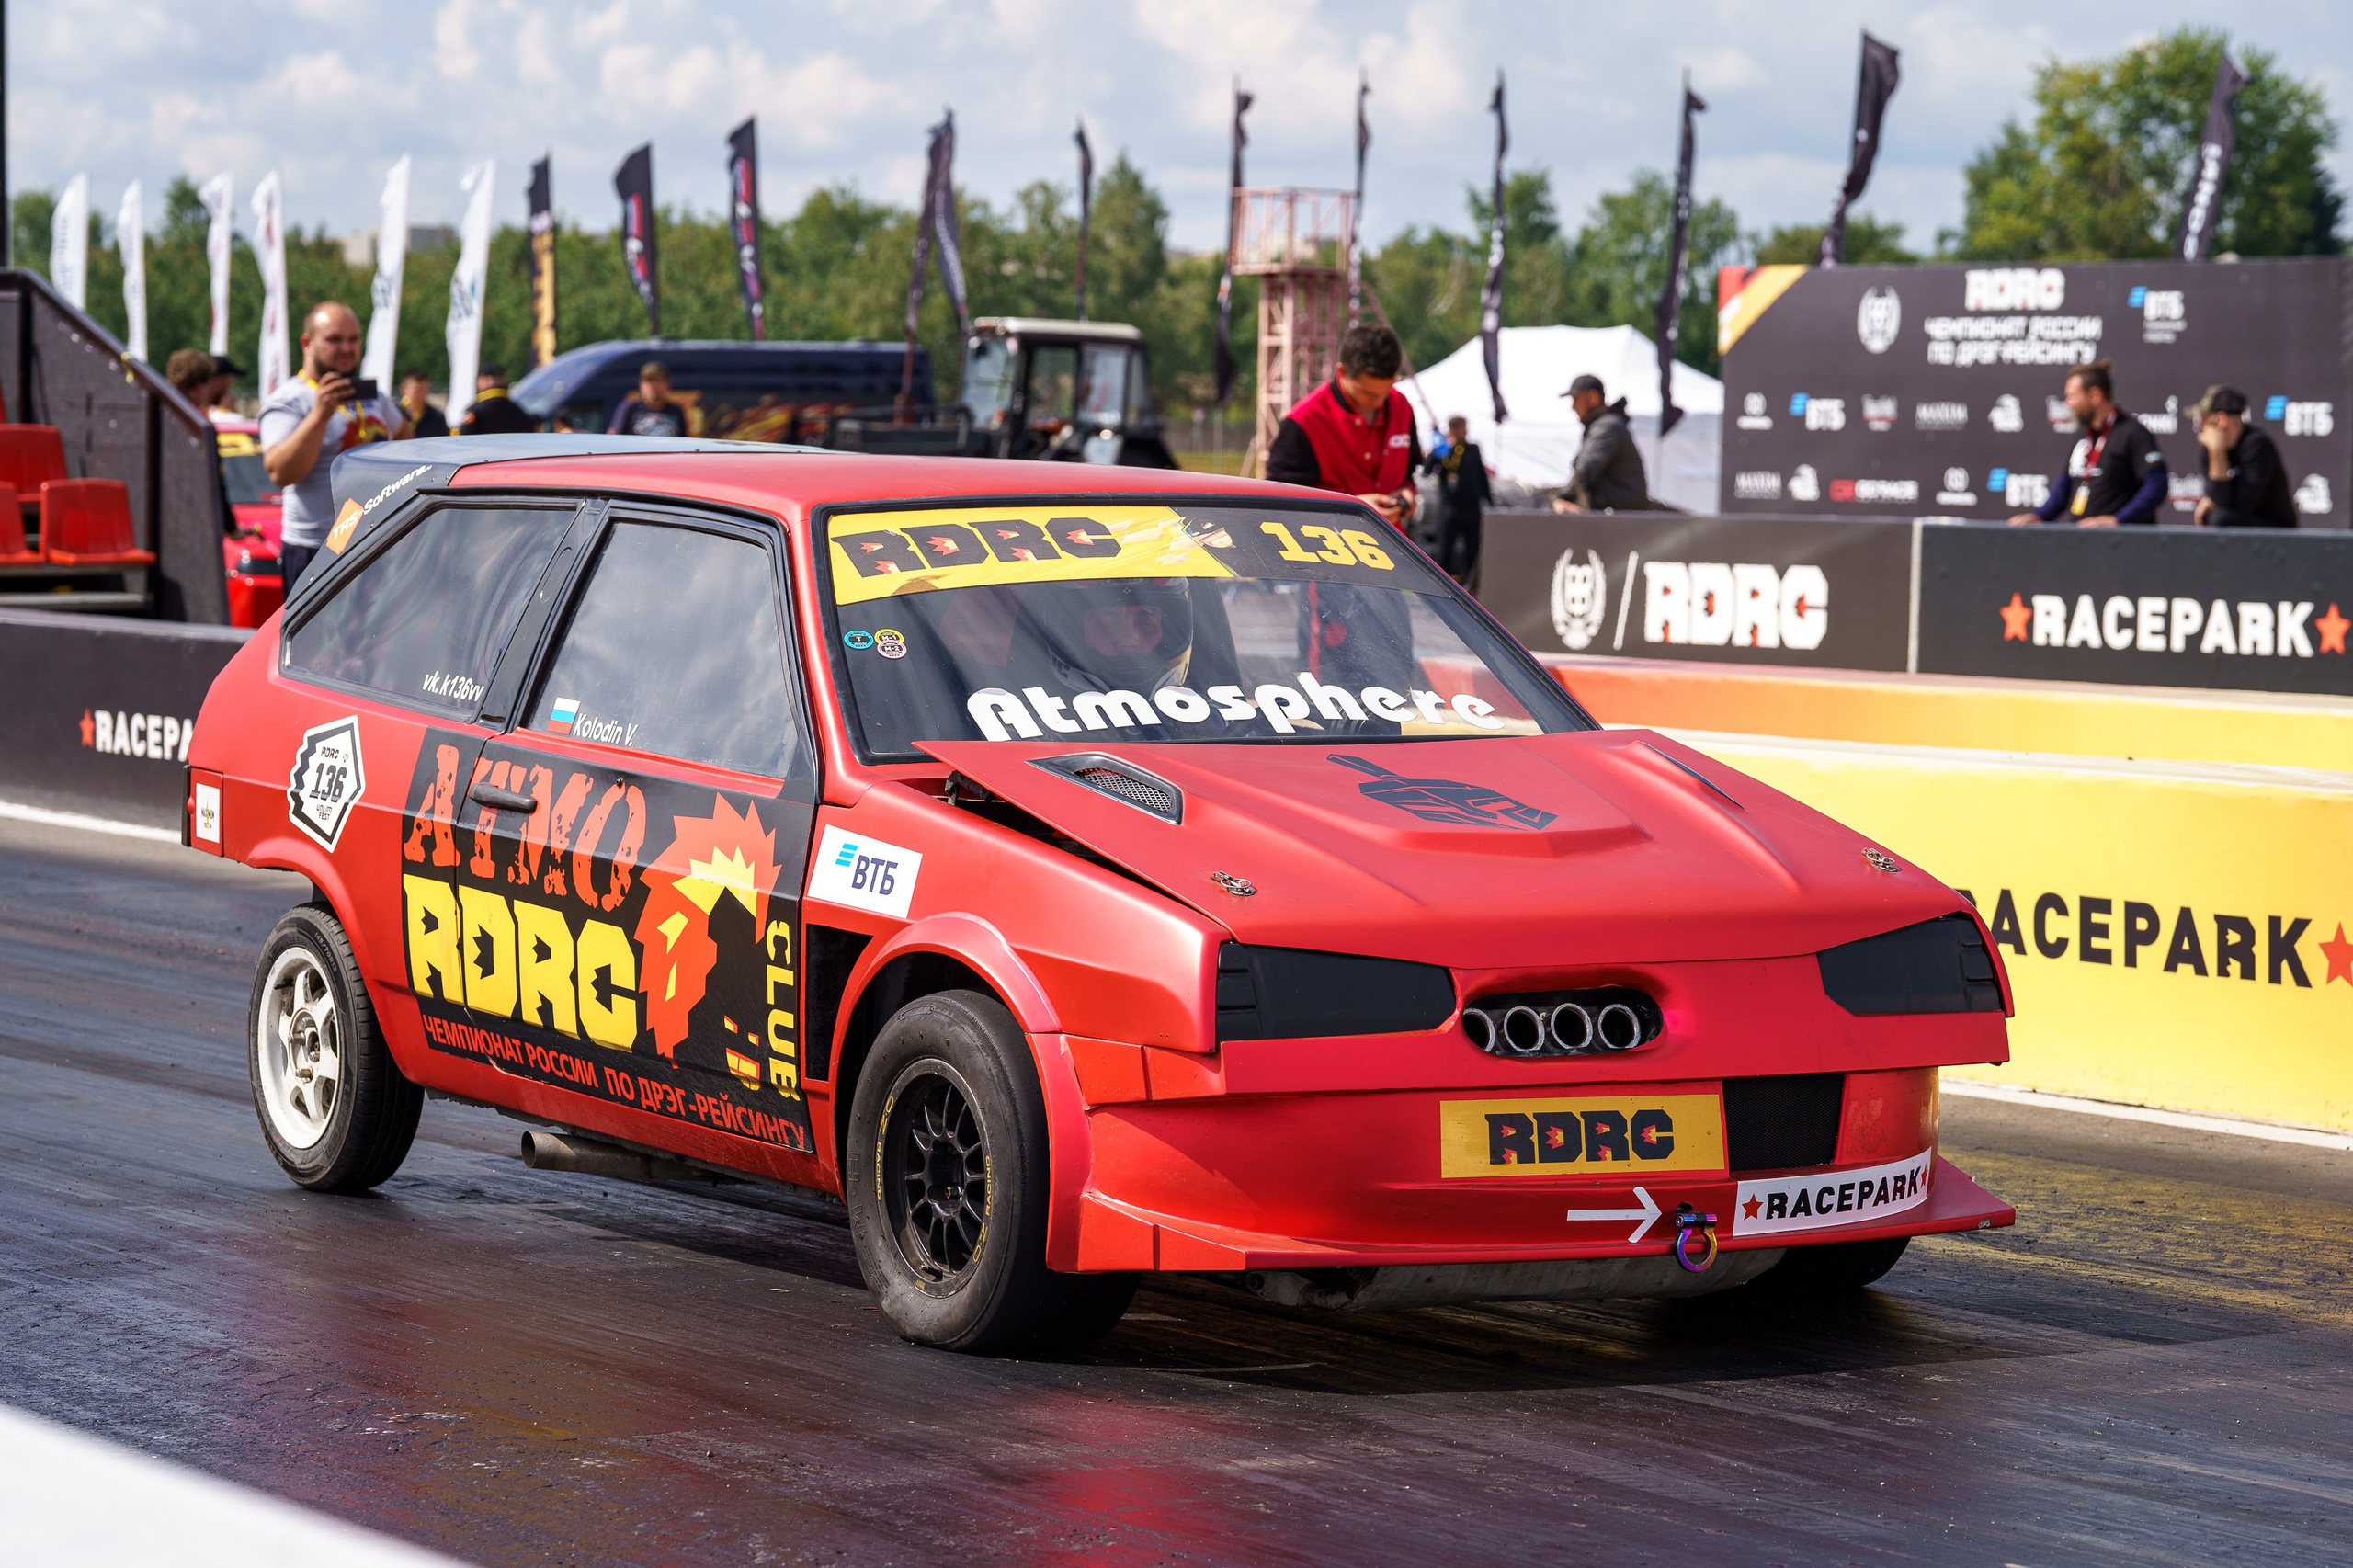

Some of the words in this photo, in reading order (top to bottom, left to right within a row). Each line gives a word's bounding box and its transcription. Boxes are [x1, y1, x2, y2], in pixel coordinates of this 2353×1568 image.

[1965, 268, 2066, 311] RDRC
[832, 517, 1122, 578] RDRC
[1262, 521, 1395, 572] 136
[1643, 561, 1829, 650] RDRC
[2031, 594, 2315, 657] RACEPARK
[573, 713, 623, 744] Kolodin
[625, 722, 639, 747] V.
[966, 672, 1506, 742] Atmosphere
[321, 746, 340, 759] RDRC
[309, 762, 347, 803] 136
[318, 812, 331, 821] FEST
[402, 744, 646, 912] ATMO
[851, 854, 898, 895] ВТБ
[403, 873, 638, 1053] RDRC
[766, 919, 801, 1102] CLUB
[423, 1014, 525, 1062] ЧЕМПИОНАТ
[524, 1038, 598, 1088] РОССИИ
[604, 1067, 634, 1100] ПО
[638, 1077, 806, 1150] ДРЭГ-РЕЙСИНГУ
[1484, 1108, 1675, 1165] RDRC
[1766, 1165, 1922, 1221] RACEPARK
